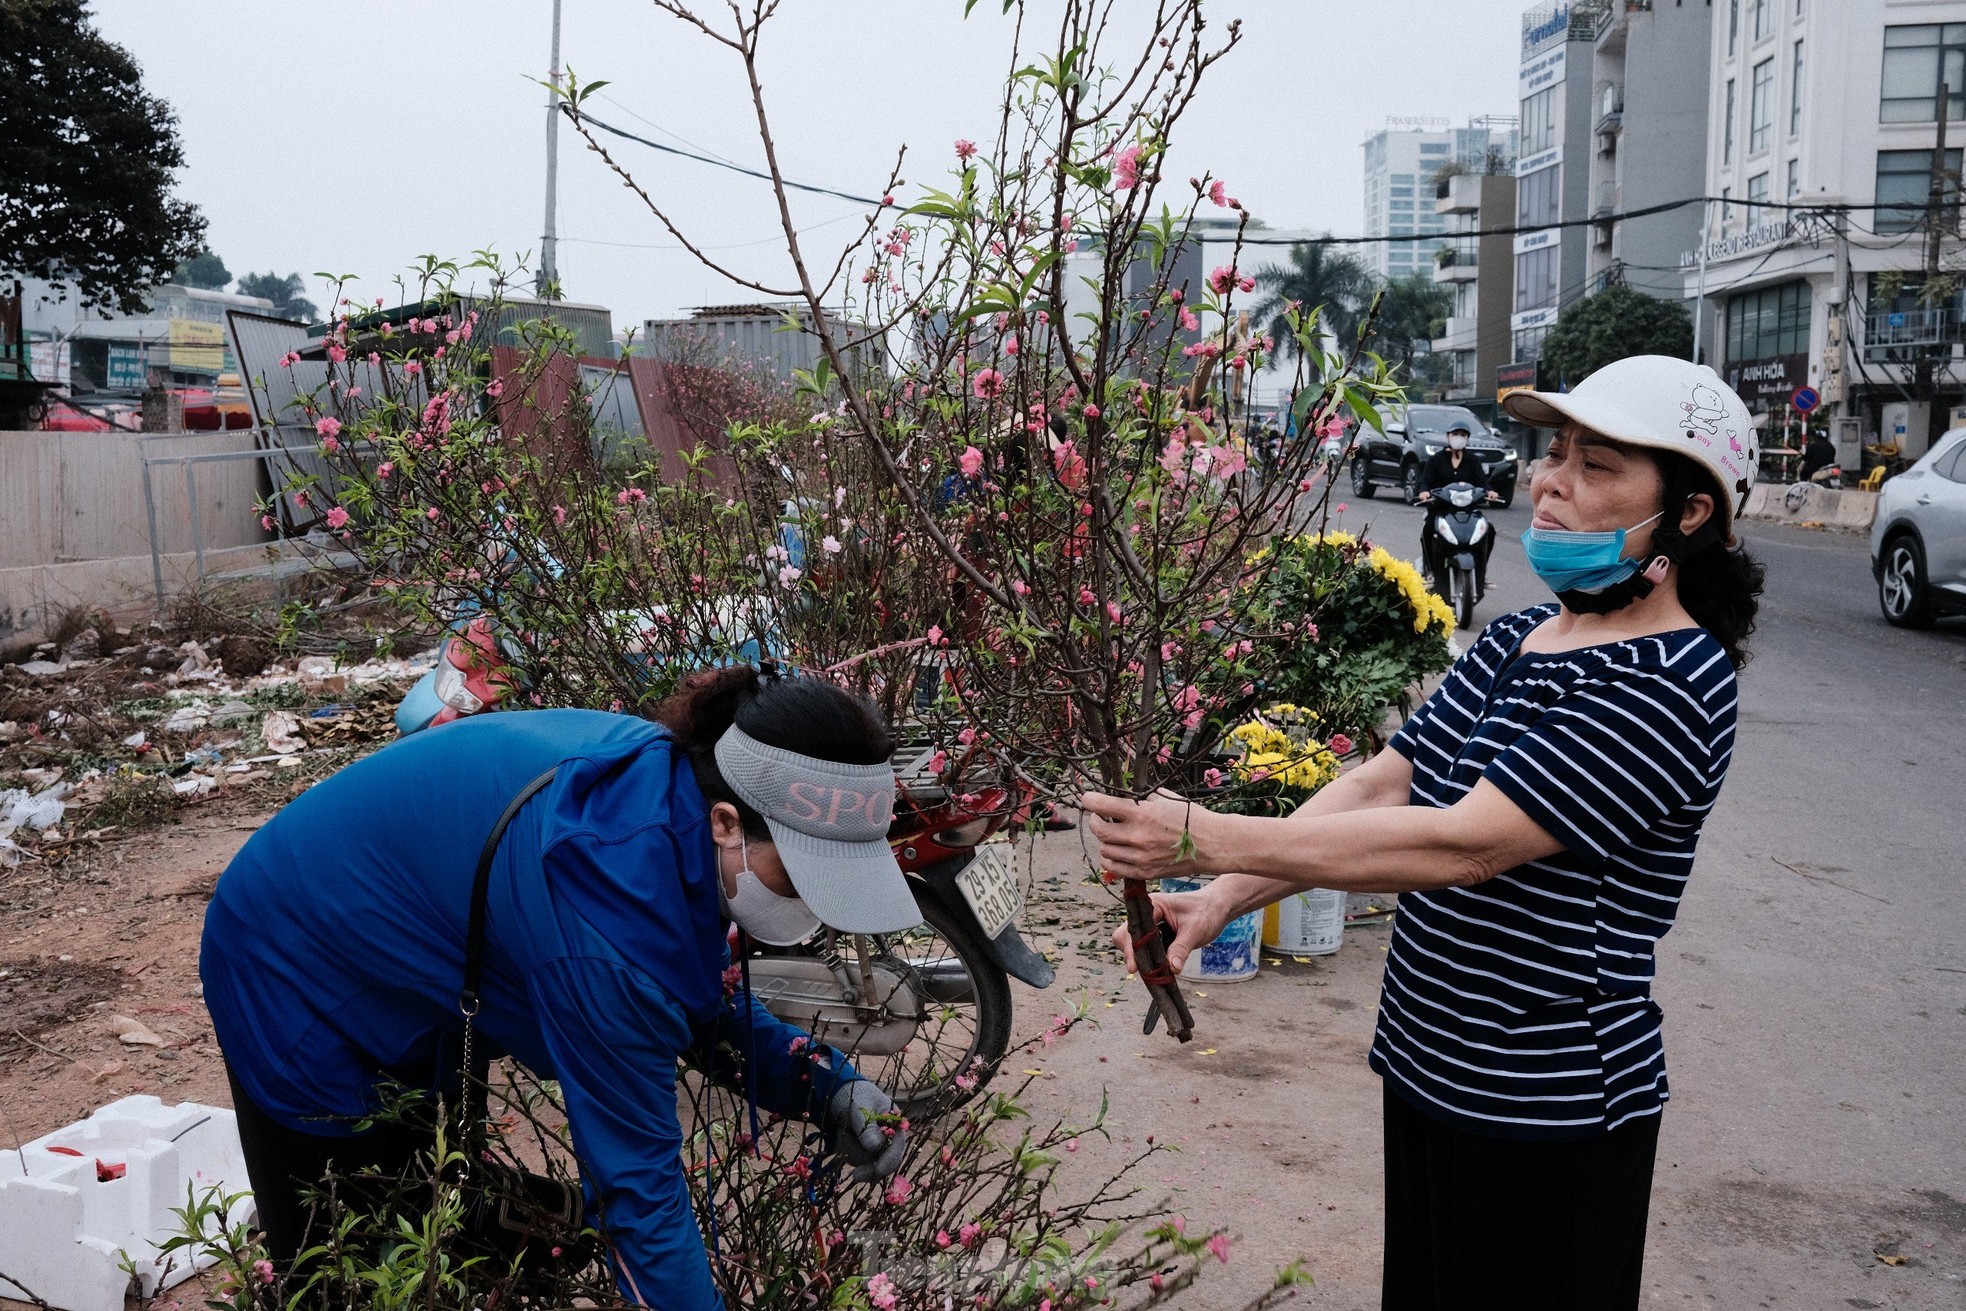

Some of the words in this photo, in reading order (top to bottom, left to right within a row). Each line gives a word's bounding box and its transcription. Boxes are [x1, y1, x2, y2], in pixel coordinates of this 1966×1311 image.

[1743, 366, 1763, 381] ANH
[1720, 455, 1741, 478] Brown
[964, 854, 1001, 902] 29-X5
[978, 880, 1019, 932] 368.05
